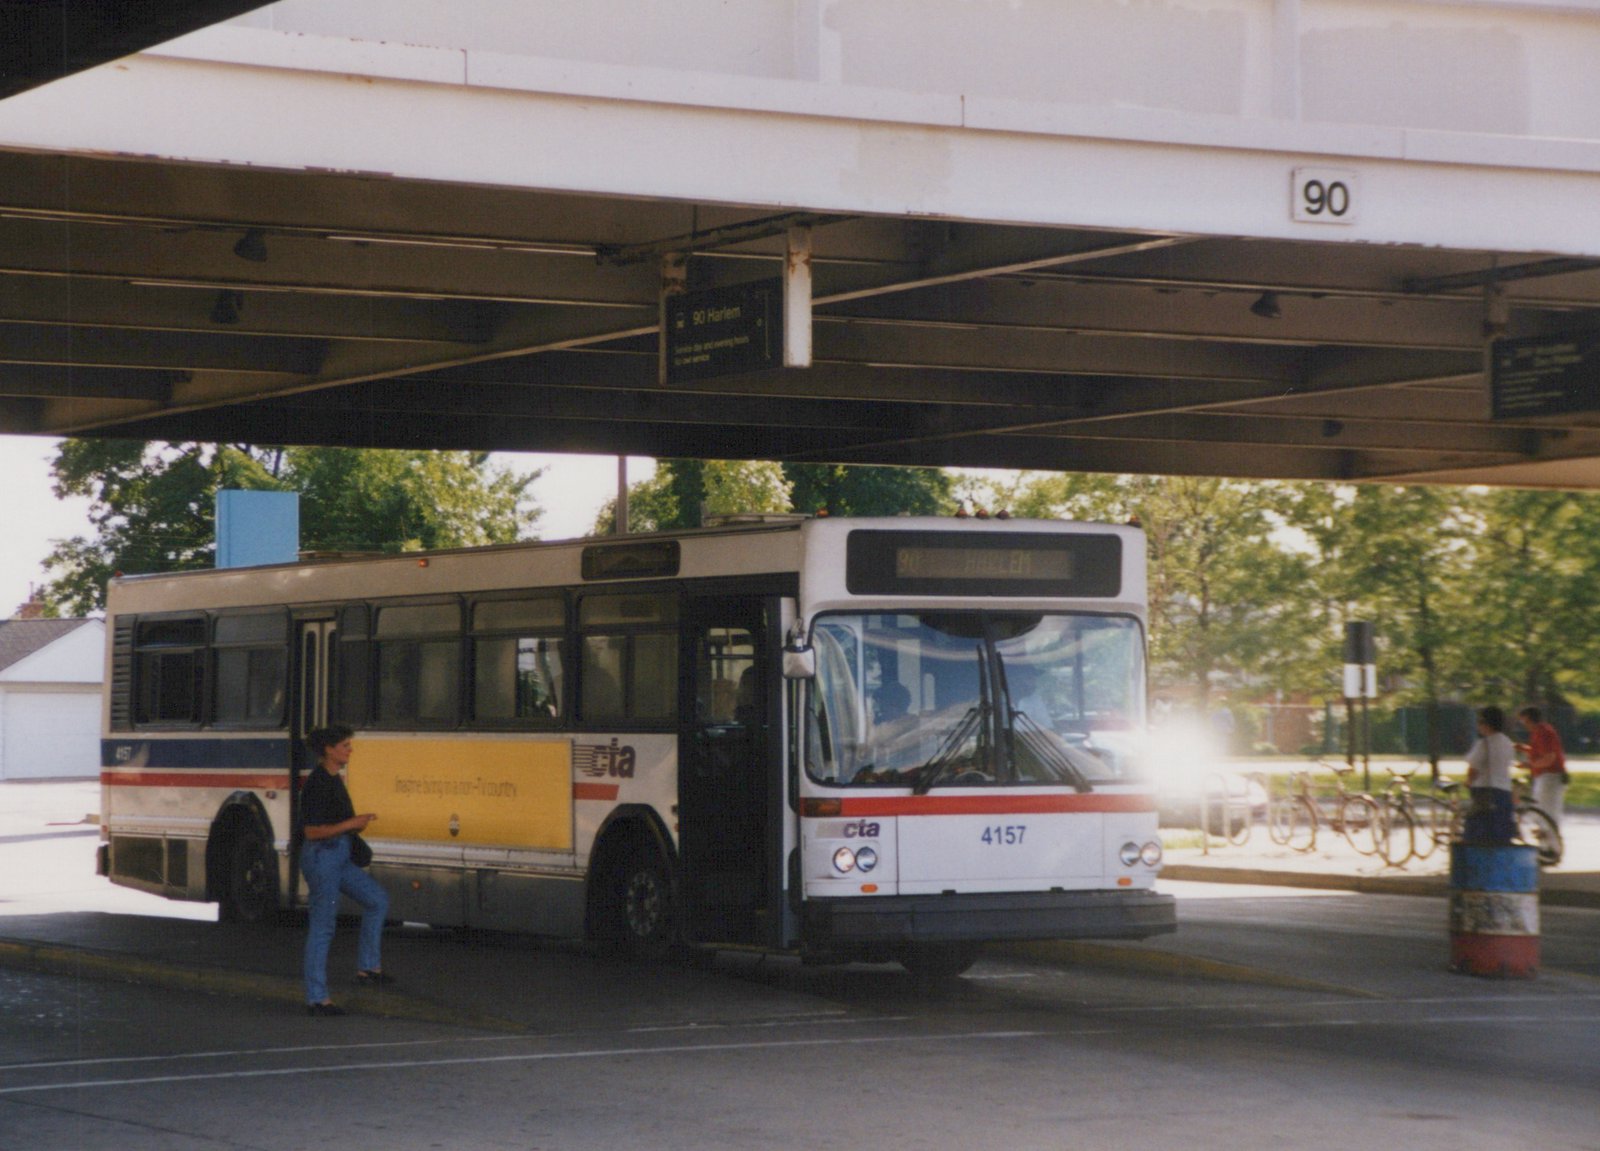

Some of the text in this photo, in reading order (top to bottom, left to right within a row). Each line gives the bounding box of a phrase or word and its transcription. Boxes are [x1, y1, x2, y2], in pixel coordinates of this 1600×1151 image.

[1303, 179, 1350, 216] 90
[692, 305, 741, 325] 90 Harlem
[588, 737, 636, 779] cta
[843, 818, 881, 839] cta
[981, 825, 1027, 845] 4157
